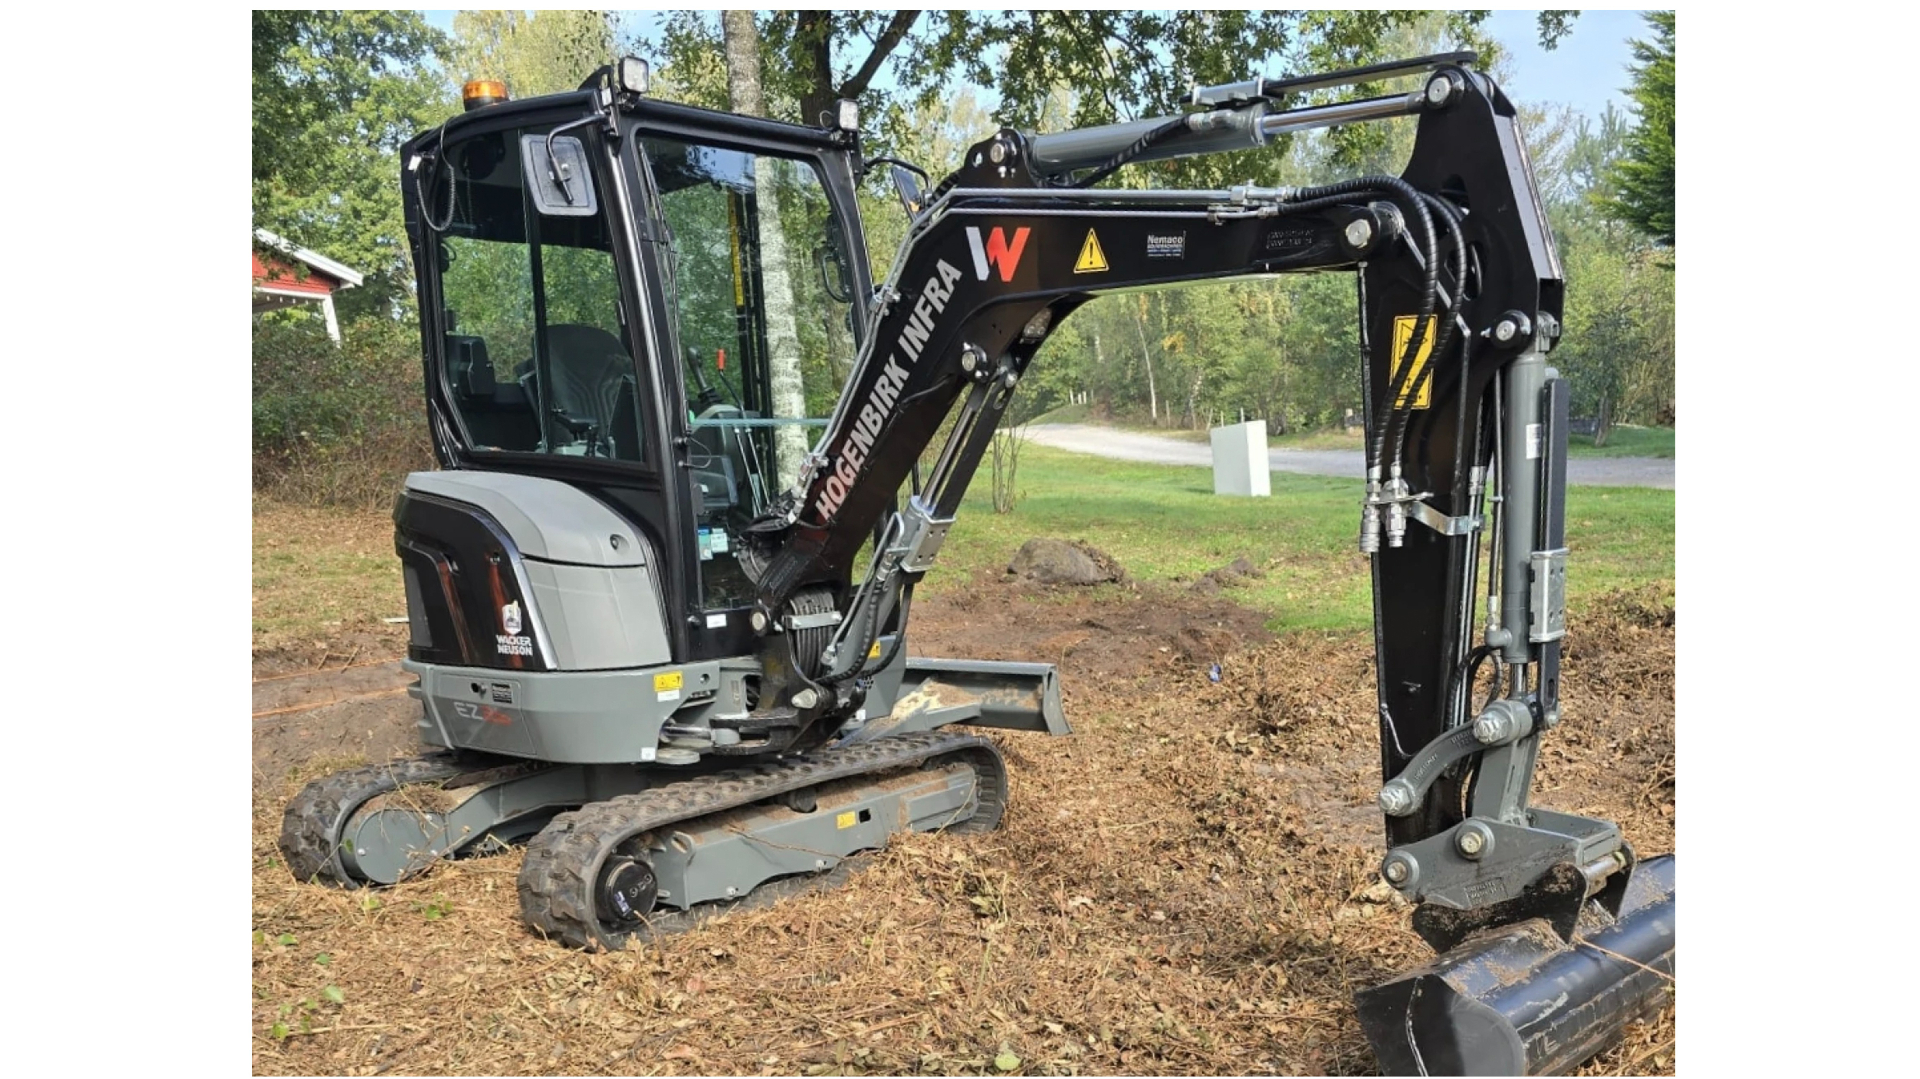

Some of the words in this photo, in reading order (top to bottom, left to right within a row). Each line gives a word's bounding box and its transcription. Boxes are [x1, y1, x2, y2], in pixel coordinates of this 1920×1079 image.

[1147, 234, 1183, 244] Nemaco
[965, 226, 1031, 282] W
[815, 353, 909, 521] HOGENBIRK
[898, 258, 963, 363] INFRA
[496, 635, 532, 646] WACKER
[497, 644, 533, 656] NEUSON
